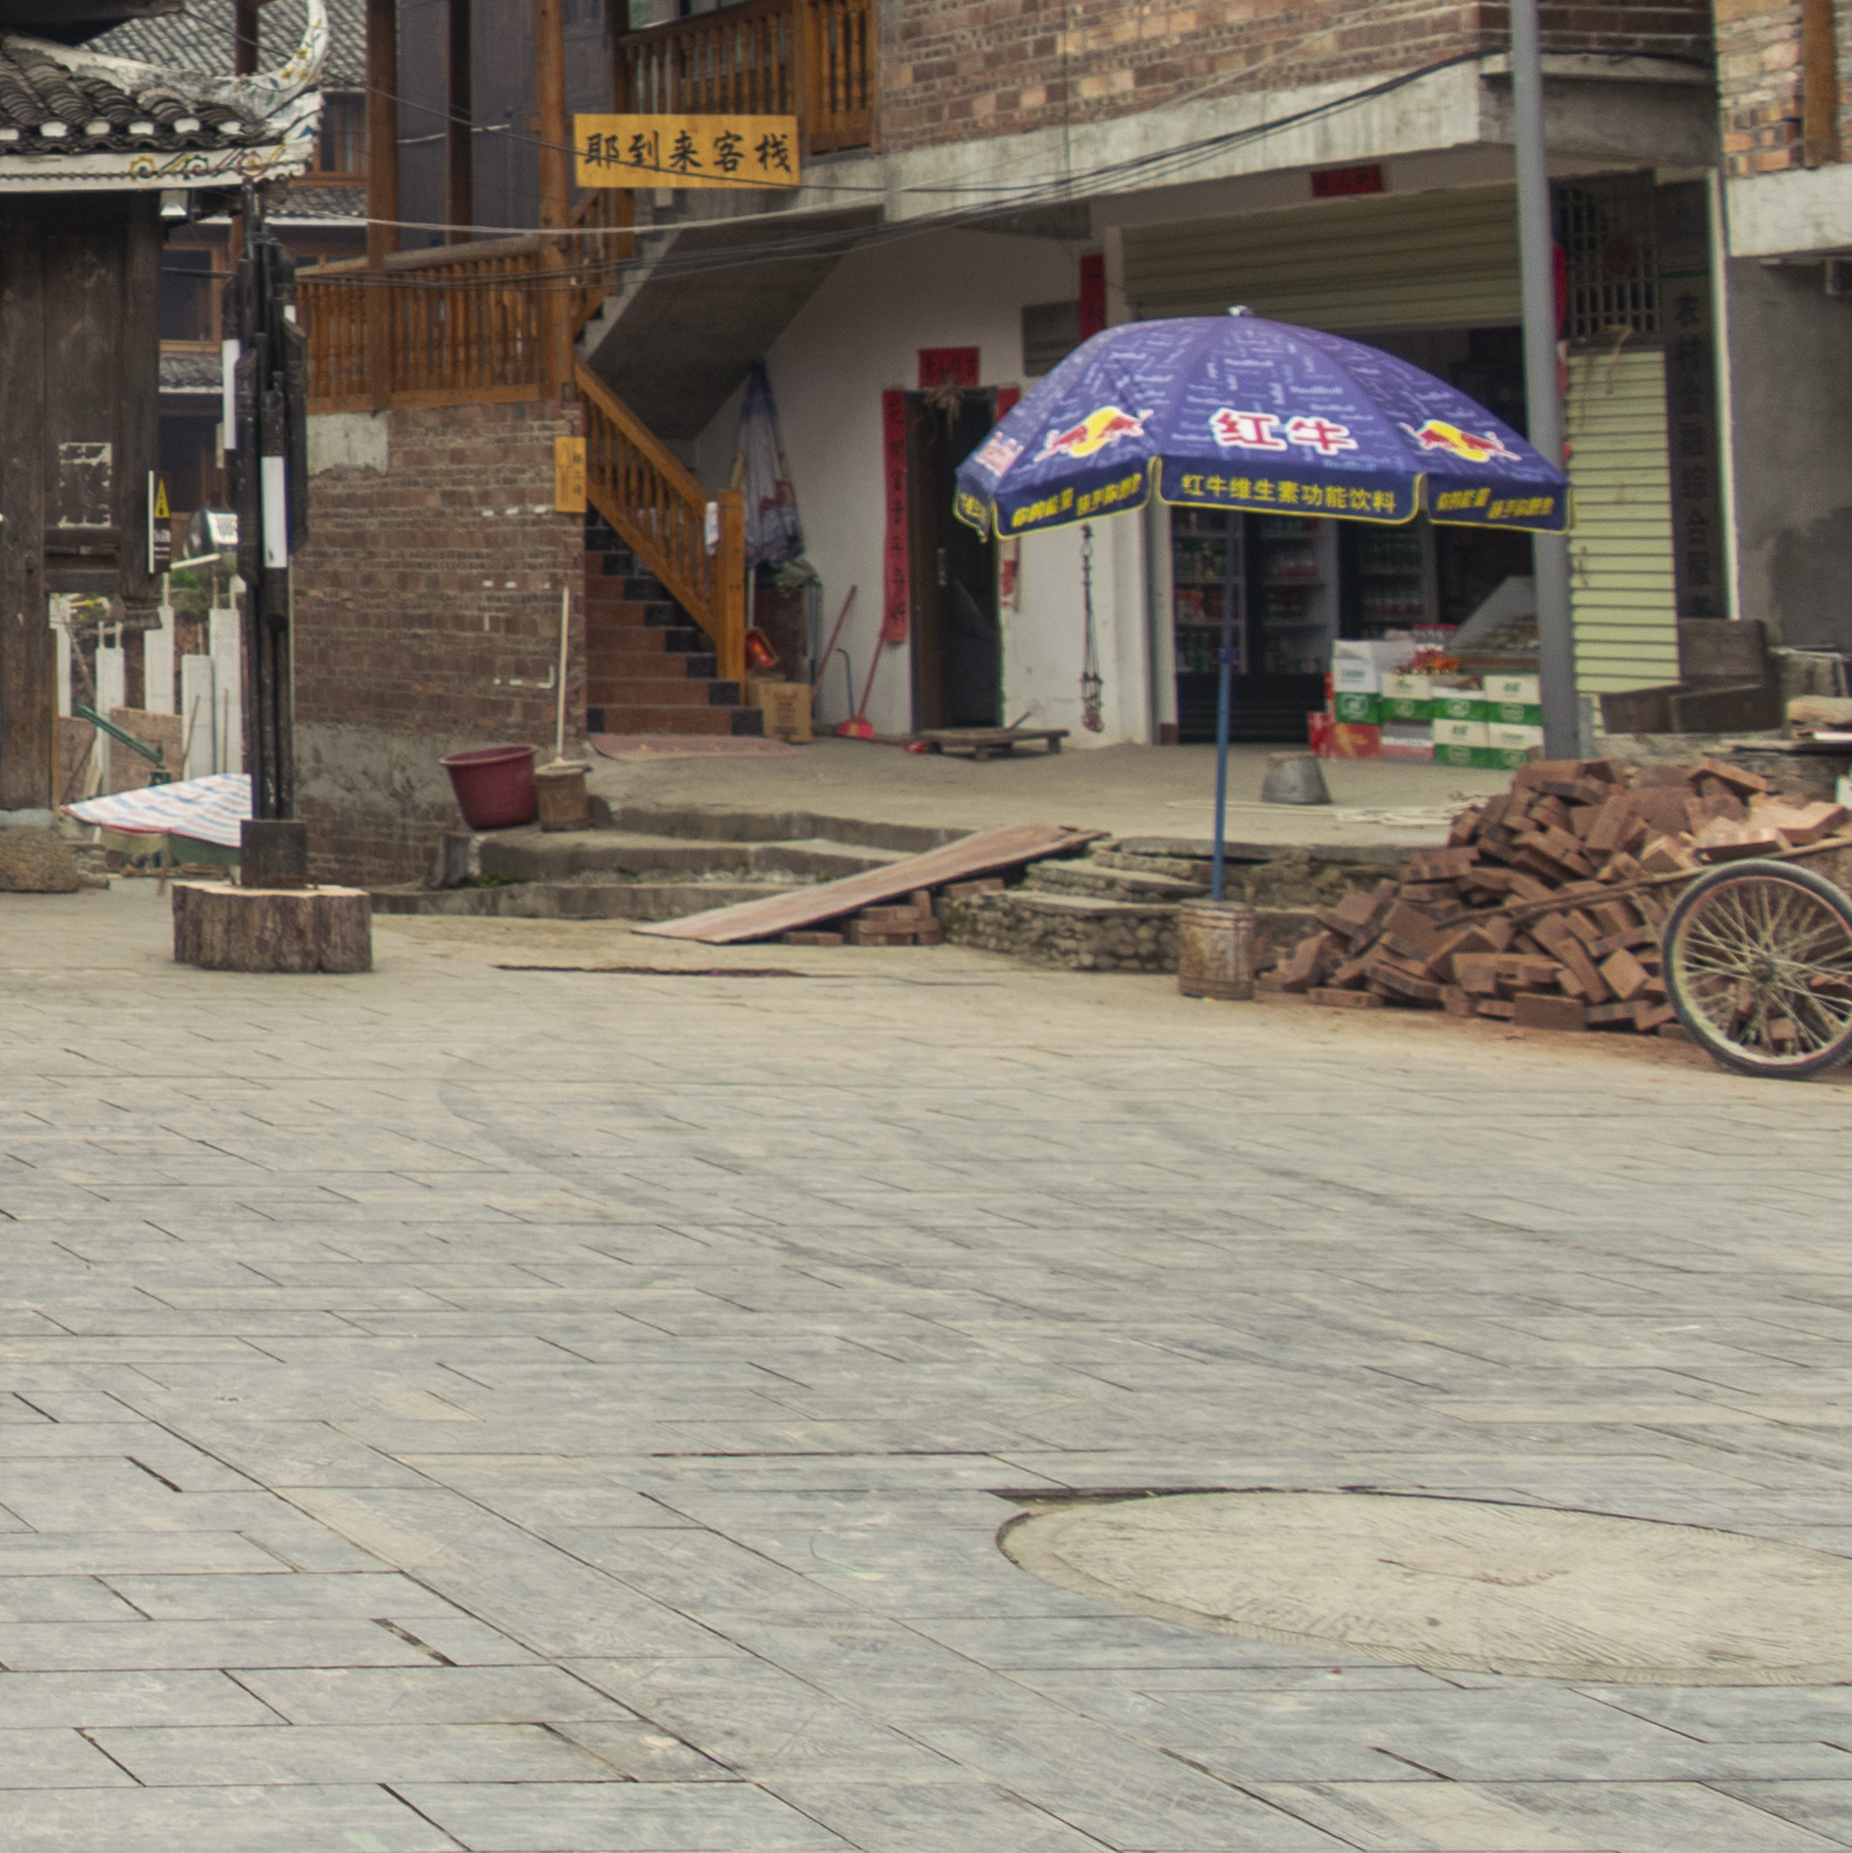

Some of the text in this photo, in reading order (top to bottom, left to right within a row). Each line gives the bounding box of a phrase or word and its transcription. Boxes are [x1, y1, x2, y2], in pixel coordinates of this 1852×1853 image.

[584, 129, 792, 174] 耶到来客栈
[1210, 408, 1358, 455] 红牛
[1181, 474, 1397, 514] 红牛维生素功能饮料
